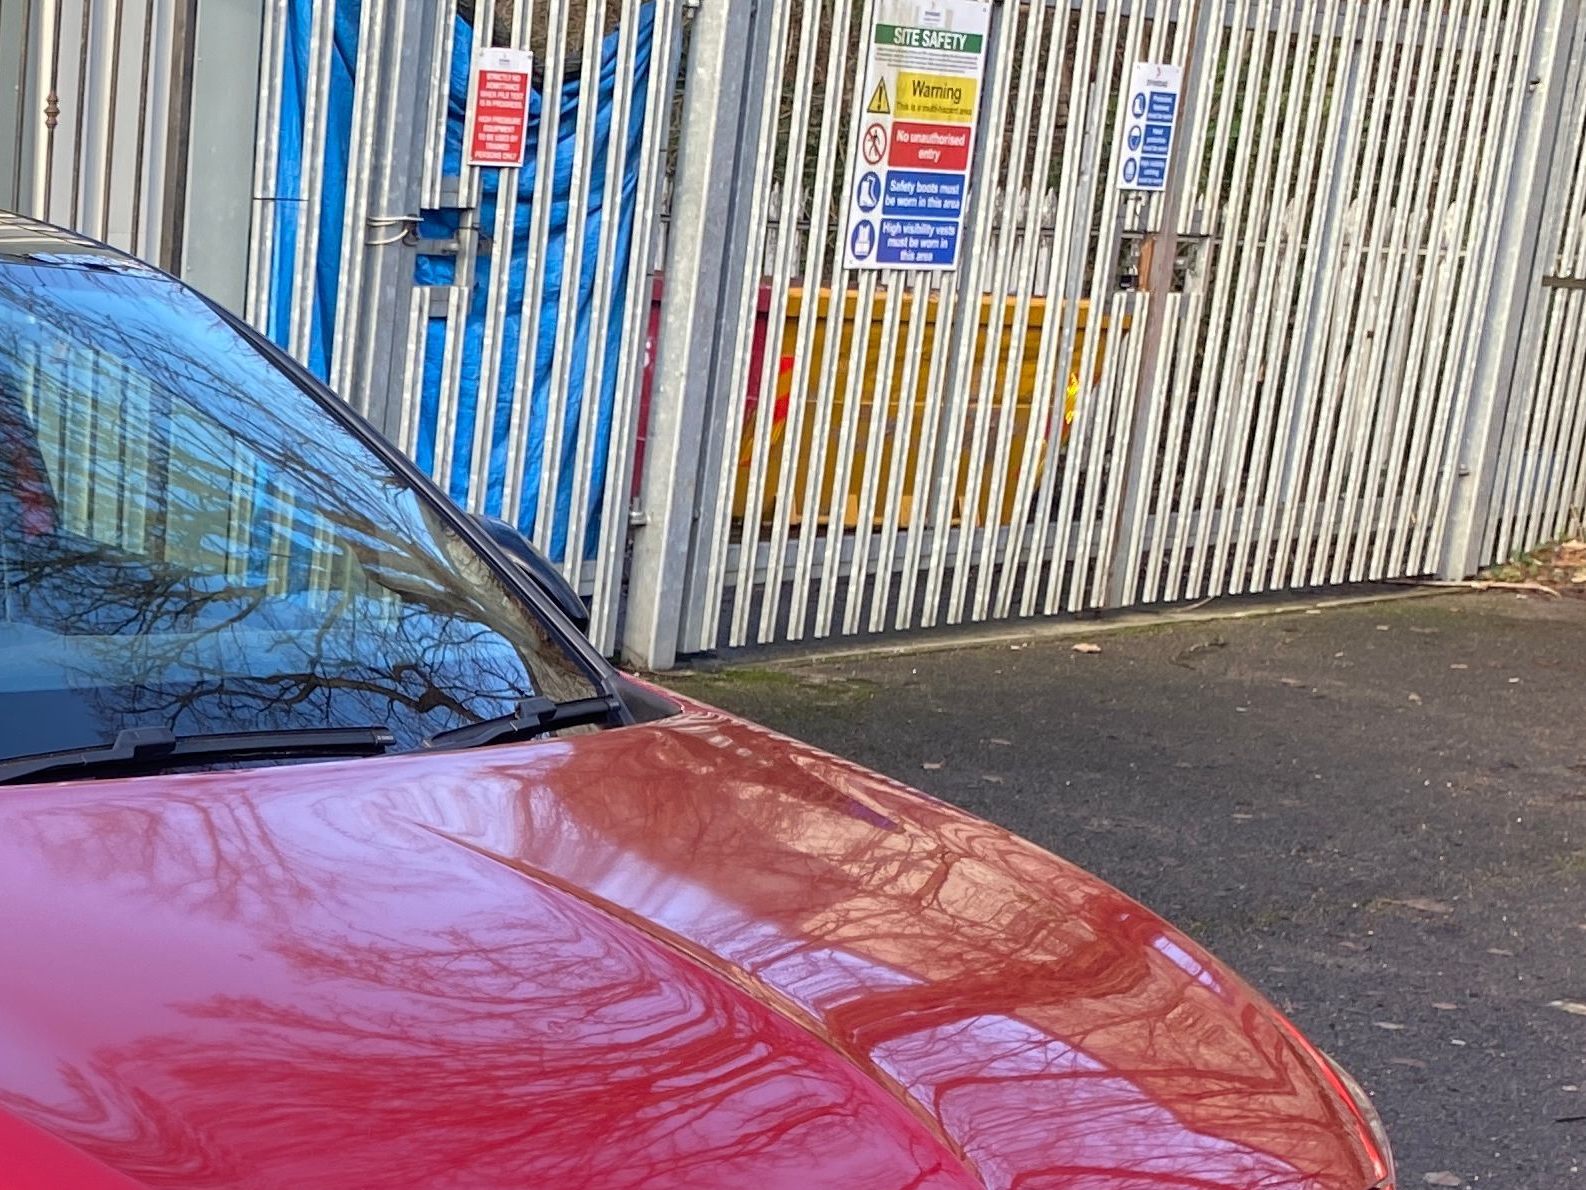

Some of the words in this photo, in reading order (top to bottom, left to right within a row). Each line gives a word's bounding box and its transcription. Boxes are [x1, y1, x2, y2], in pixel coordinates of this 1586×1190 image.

[893, 27, 919, 46] SITE
[921, 31, 967, 50] SAFETY
[512, 74, 522, 82] NO
[479, 90, 497, 98] WHEN
[510, 92, 524, 100] TEST
[912, 79, 962, 104] Warning
[478, 99, 486, 107] IS
[486, 99, 492, 107] IN
[896, 101, 908, 111] This
[477, 115, 492, 123] HIGH
[492, 116, 522, 125] PRESSURE
[482, 124, 515, 133] EQUIPMENT
[477, 132, 486, 140] TO
[486, 133, 494, 141] BE
[494, 133, 510, 142] USED
[510, 134, 519, 143] BY
[896, 130, 908, 142] No
[910, 131, 965, 146] unauthorised
[474, 150, 502, 160] PERSONS
[502, 152, 518, 160] ONLY
[918, 149, 941, 163] entry
[890, 180, 915, 194] Safety
[916, 181, 938, 193] boots
[939, 183, 959, 194] must
[885, 195, 896, 207] be
[896, 197, 918, 207] worn
[918, 197, 926, 207] in
[927, 197, 942, 208] this
[943, 199, 960, 209] area
[882, 222, 902, 236] High
[903, 223, 935, 237] visibility
[935, 225, 956, 235] vests
[887, 237, 908, 248] must
[909, 237, 919, 248] be
[920, 239, 940, 249] worn
[941, 239, 948, 249] in
[900, 250, 916, 261] this
[916, 252, 934, 262] area
